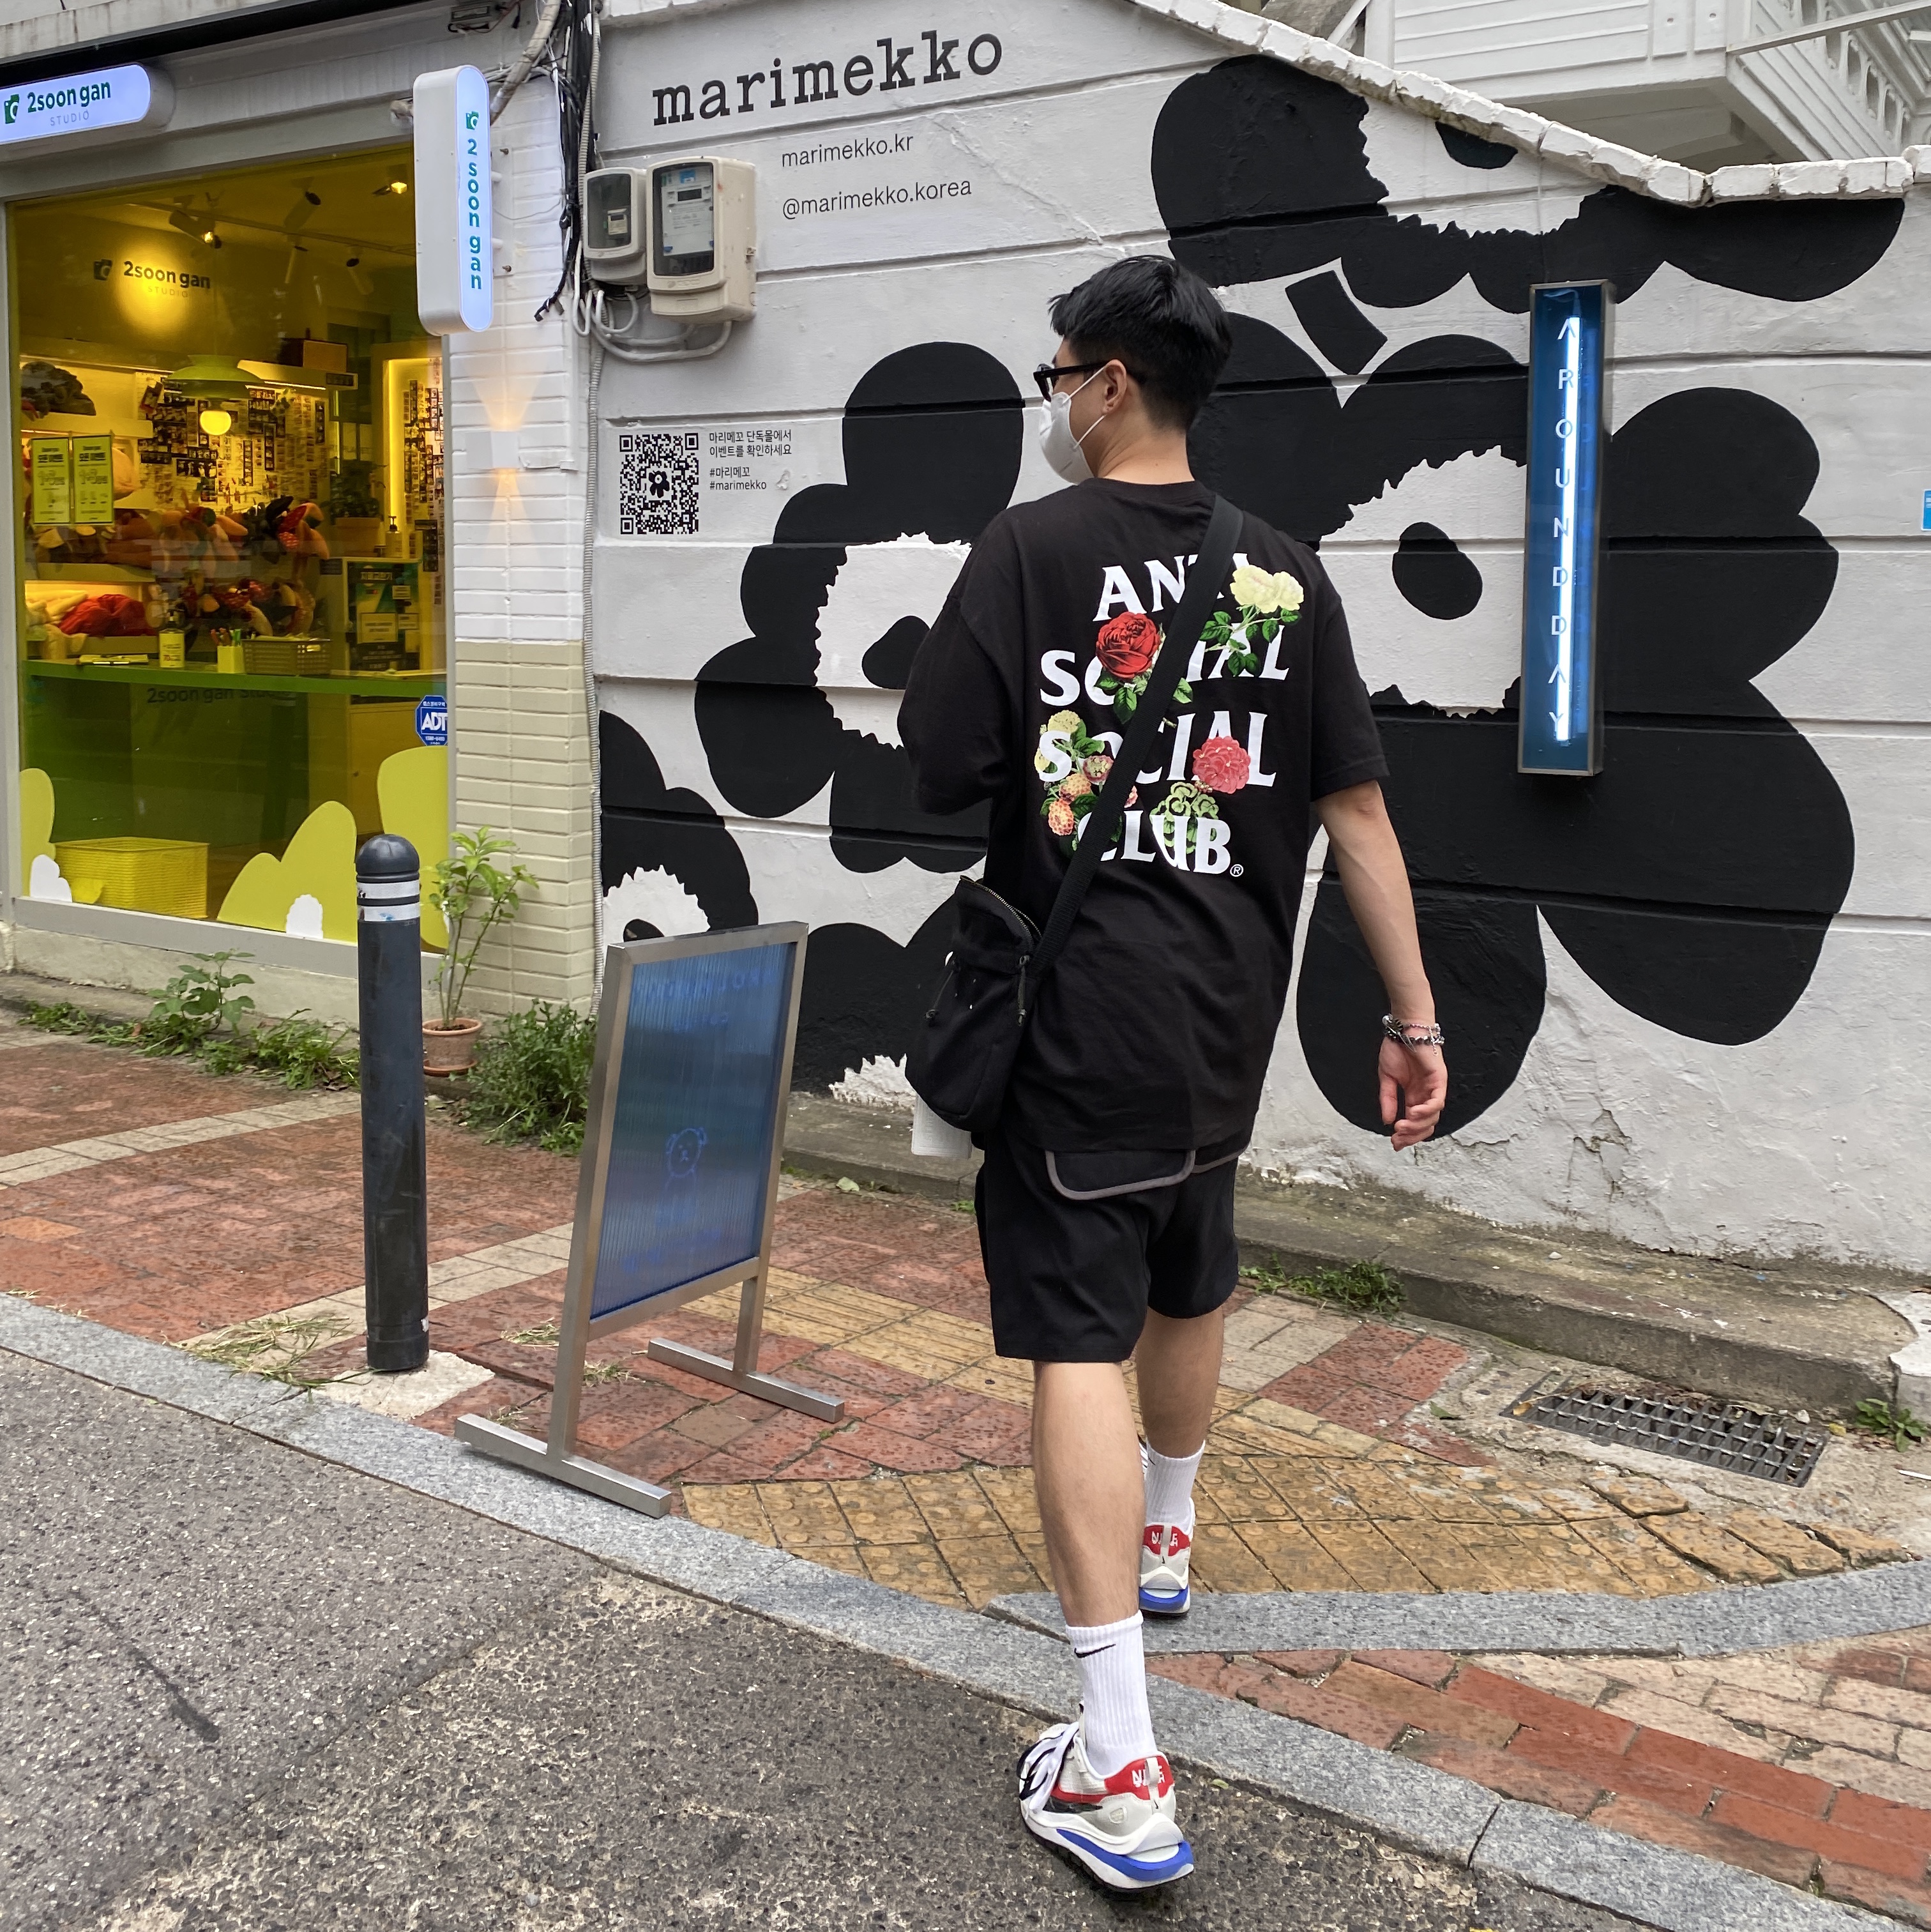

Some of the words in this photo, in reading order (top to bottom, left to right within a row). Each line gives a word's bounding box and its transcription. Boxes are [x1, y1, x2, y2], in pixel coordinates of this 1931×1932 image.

[653, 30, 1002, 126] marimekko
[27, 88, 77, 113] 2soon
[80, 81, 111, 107] gan
[50, 110, 89, 126] STUDIO
[782, 133, 914, 167] marimekko.kr
[467, 138, 480, 228] 2soon
[783, 180, 972, 220] @marimekko.korea
[124, 261, 176, 284] 2soon
[179, 272, 210, 289] gan
[470, 235, 482, 290] gan
[148, 285, 188, 298] STUDIO
[709, 431, 744, 443] 마리메꼬
[746, 429, 792, 443] 단독몰에서
[709, 445, 744, 458] 이벤트를
[746, 444, 792, 457] 확인하세요
[709, 480, 767, 491] #marimekko
[1093, 553, 1248, 622] AN
[1040, 622, 1289, 707] SIAL
[421, 712, 448, 731] ADT
